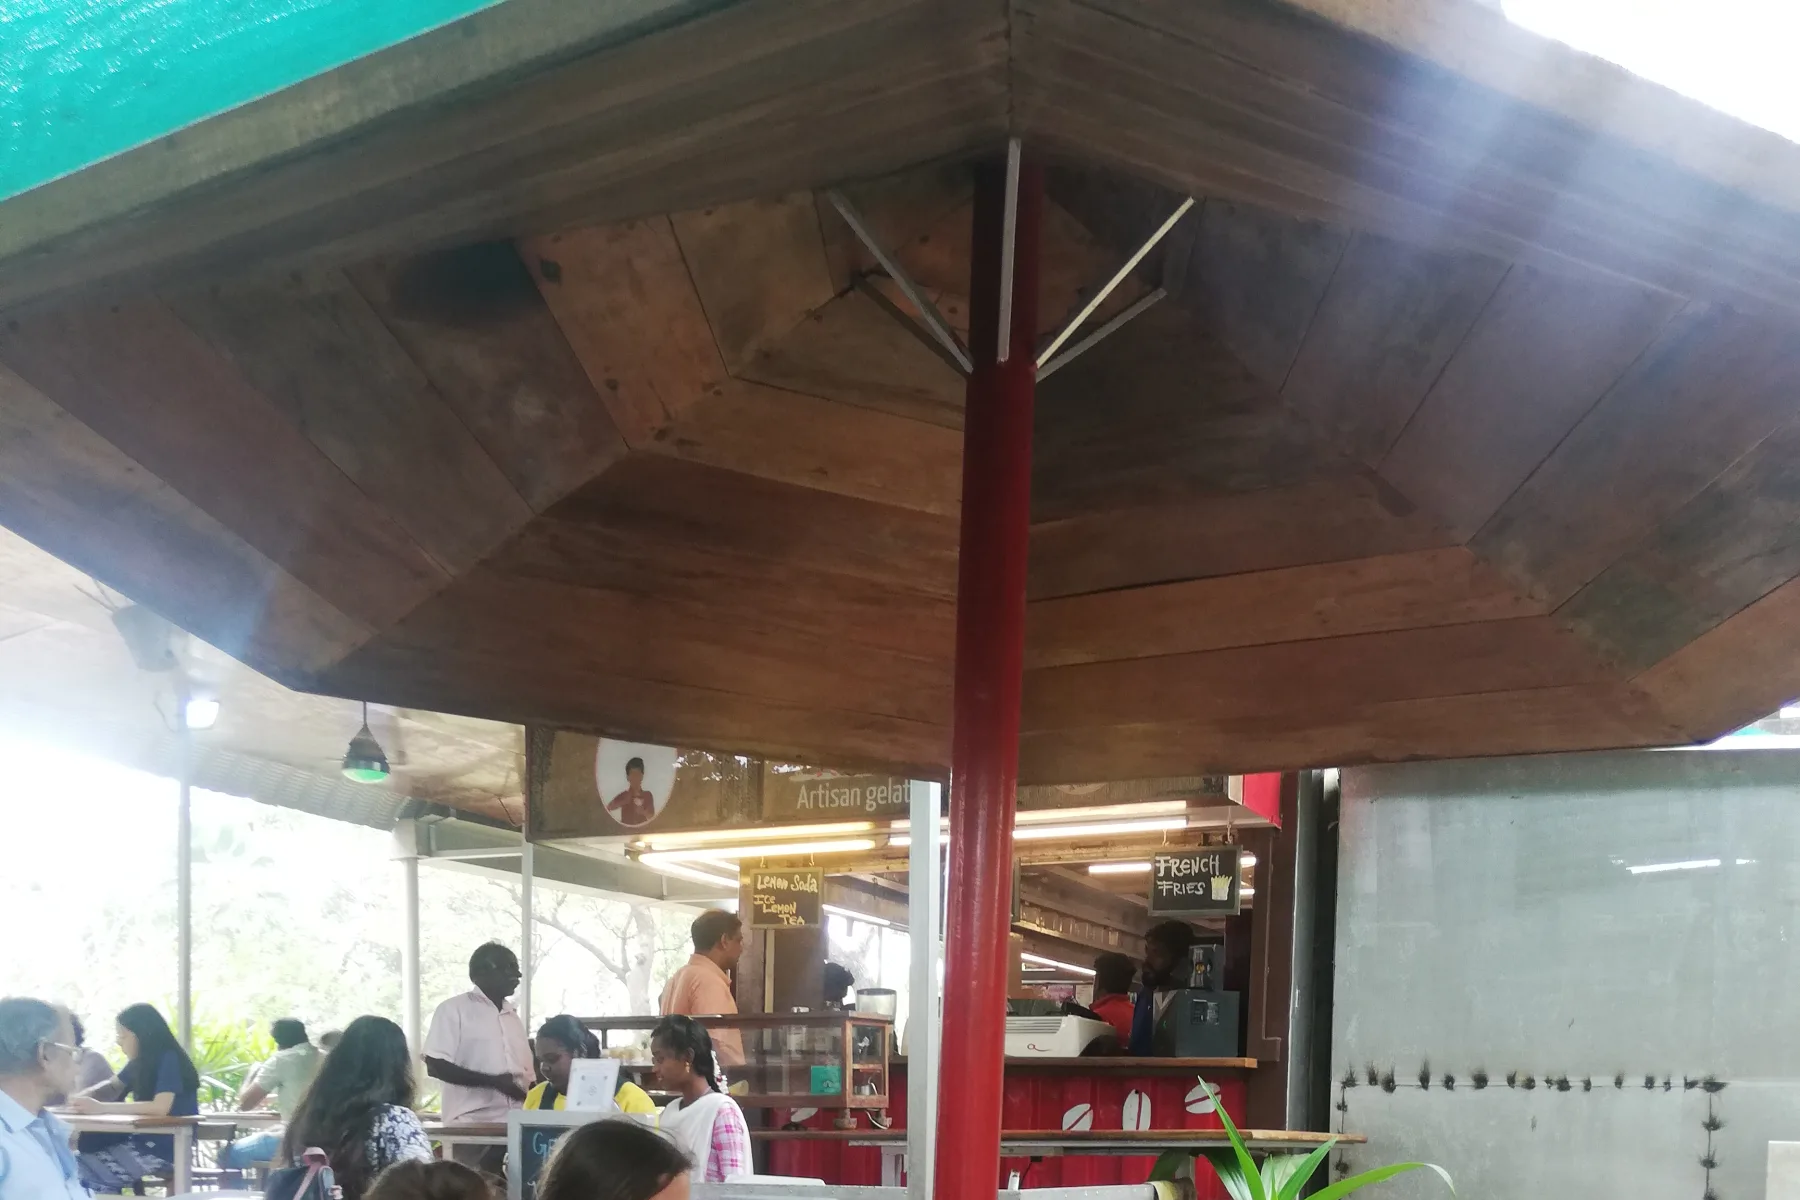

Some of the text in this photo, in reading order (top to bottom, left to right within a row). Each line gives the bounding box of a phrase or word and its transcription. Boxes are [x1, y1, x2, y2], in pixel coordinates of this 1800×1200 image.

[796, 782, 861, 809] Artisan
[1155, 854, 1220, 878] FRENCH
[790, 873, 818, 893] Soda
[1157, 880, 1206, 897] FRIES
[778, 914, 805, 926] TEA
